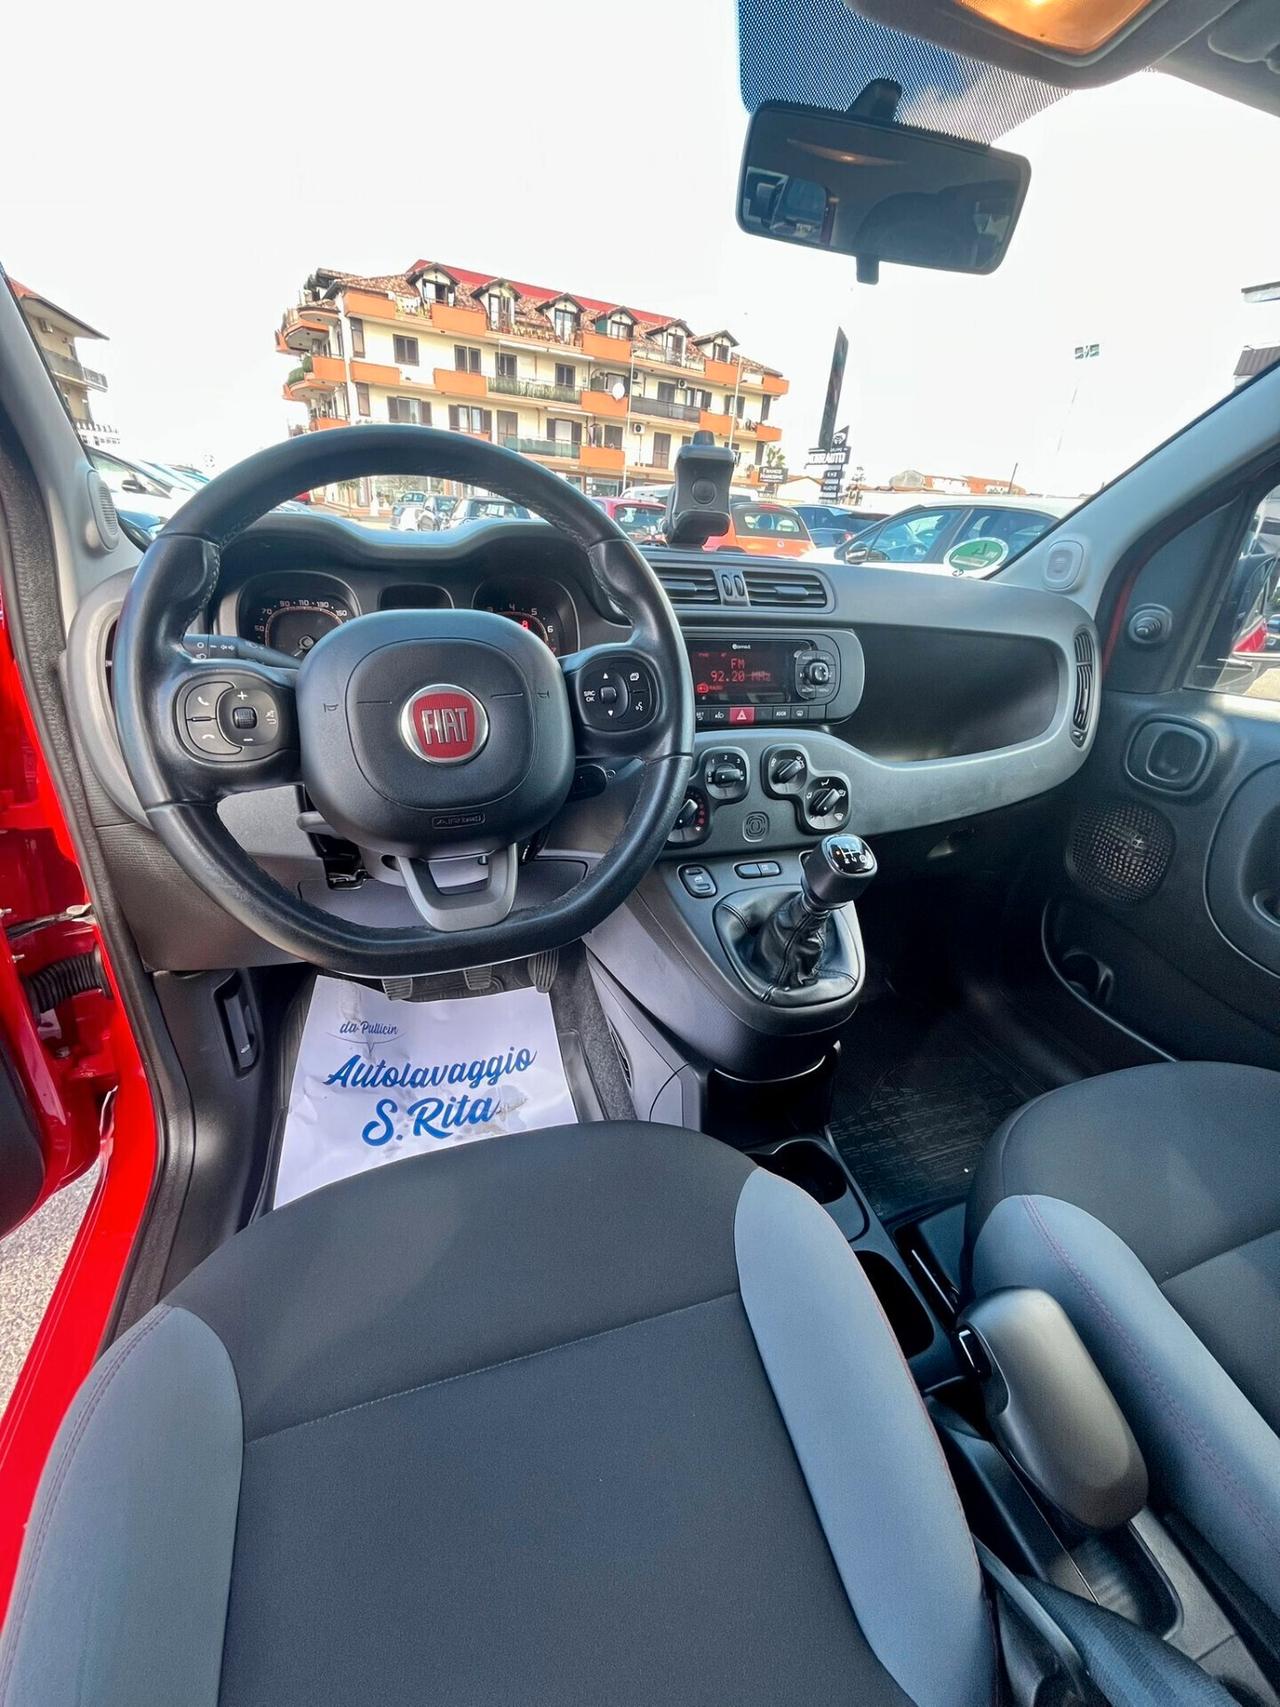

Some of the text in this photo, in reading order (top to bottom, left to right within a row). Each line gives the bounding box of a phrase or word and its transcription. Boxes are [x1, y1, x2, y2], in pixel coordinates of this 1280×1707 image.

[508, 603, 516, 611] 4
[531, 607, 538, 616] 5
[547, 625, 554, 633] 6
[730, 658, 745, 669] FM
[710, 670, 745, 682] 92.20
[421, 708, 468, 745] FIAT
[340, 1020, 360, 1035] da
[322, 1046, 538, 1089] Autolavaggio
